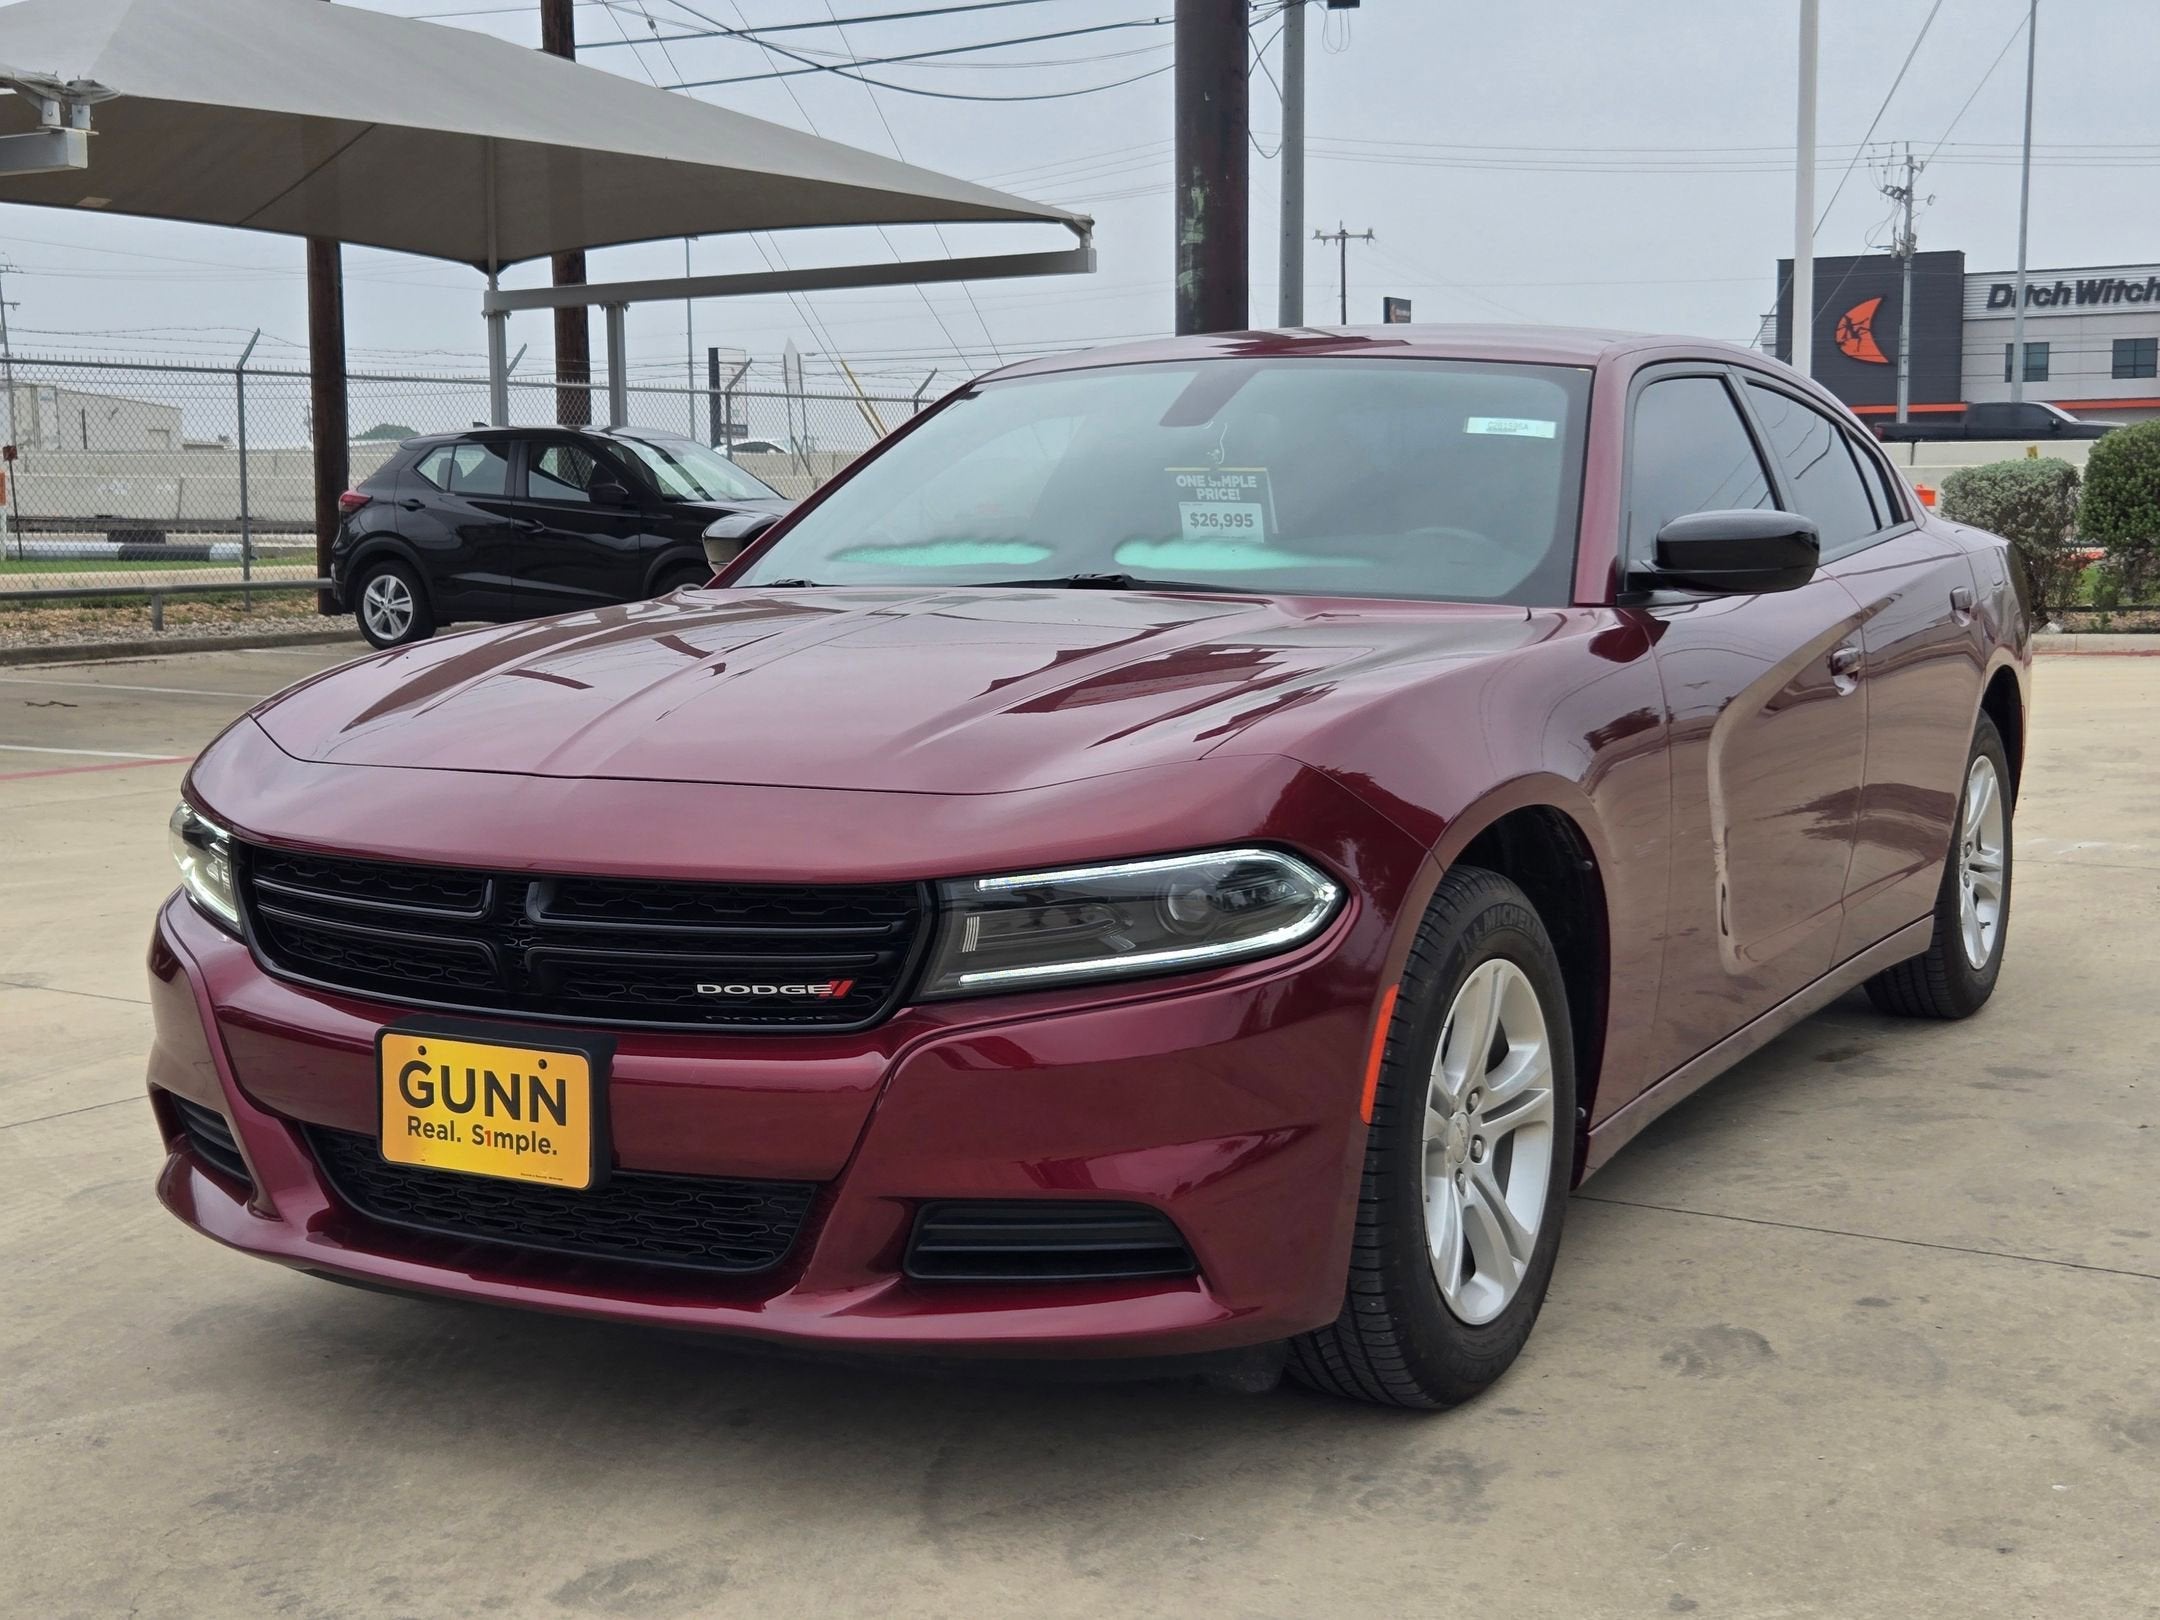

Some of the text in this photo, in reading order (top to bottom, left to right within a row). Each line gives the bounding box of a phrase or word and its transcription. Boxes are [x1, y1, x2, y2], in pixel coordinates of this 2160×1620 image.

[2075, 277, 2160, 304] Witch
[1176, 475, 1206, 488] ONE
[1196, 488, 1240, 501] PRICE!
[1190, 512, 1254, 530] $26,995
[697, 984, 832, 995] DODGE
[399, 1060, 567, 1127] GUNN
[407, 1115, 461, 1142] Real.
